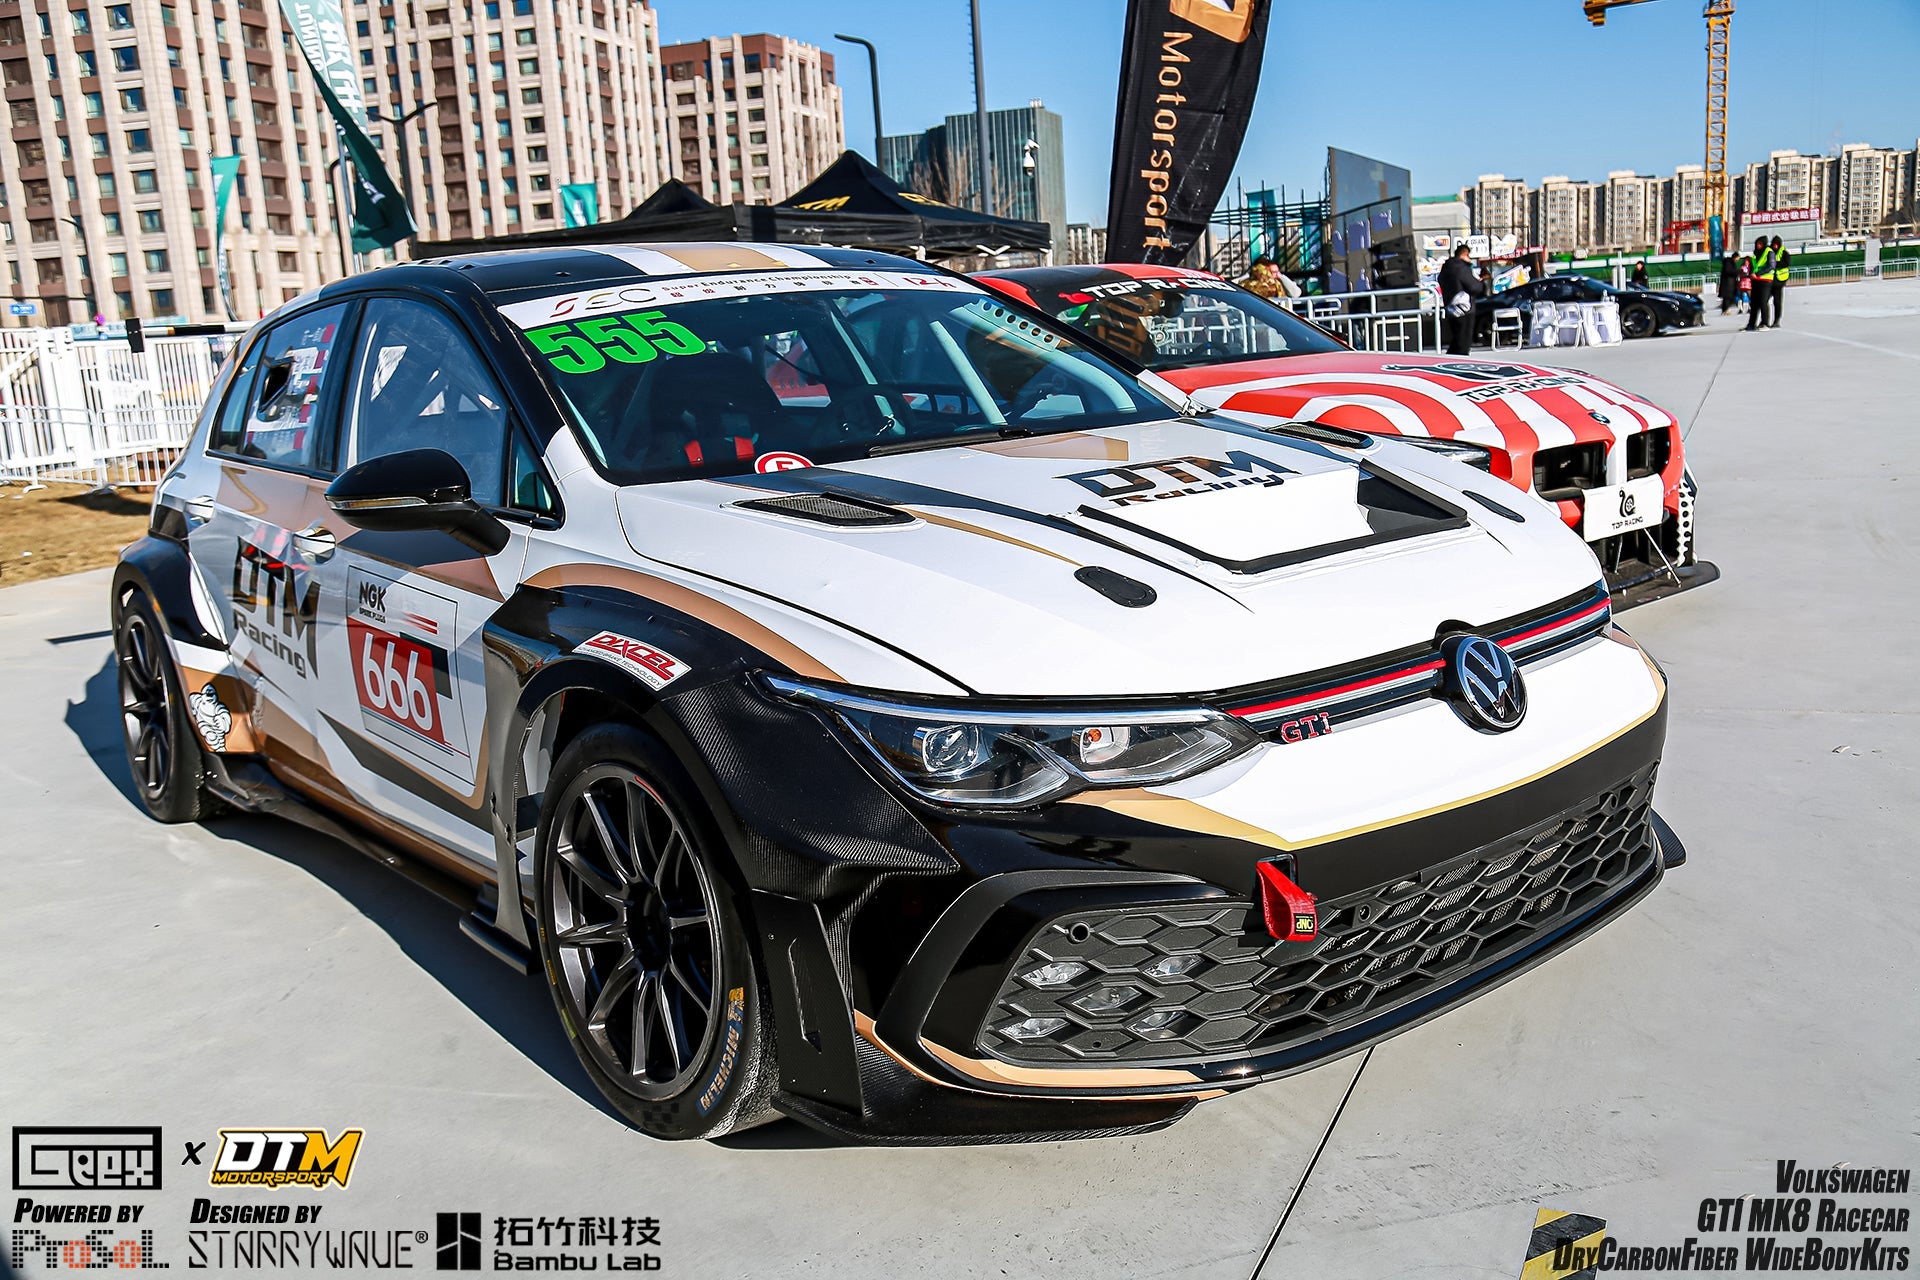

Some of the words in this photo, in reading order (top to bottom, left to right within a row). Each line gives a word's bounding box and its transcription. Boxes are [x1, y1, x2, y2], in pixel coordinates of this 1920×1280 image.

[1141, 31, 1194, 251] Motorsport
[662, 284, 700, 292] Super
[700, 278, 767, 287] Endurance
[768, 274, 852, 282] Championship
[1080, 281, 1144, 298] TOP
[1142, 278, 1237, 292] RACING
[524, 310, 707, 374] 555
[1456, 385, 1508, 401] TOP
[1051, 450, 1303, 498] DTM
[1109, 474, 1285, 507] Racing
[1612, 521, 1624, 530] TOP
[1625, 516, 1643, 527] RACING
[233, 536, 321, 680] DTM
[359, 580, 388, 613] NGK
[233, 606, 307, 680] Racing
[592, 634, 676, 679] DIXCEL
[361, 632, 433, 732] 666
[621, 660, 662, 687] TECHNOLOGY
[1281, 711, 1333, 744] GTI
[700, 1025, 740, 1111] MICHELIN
